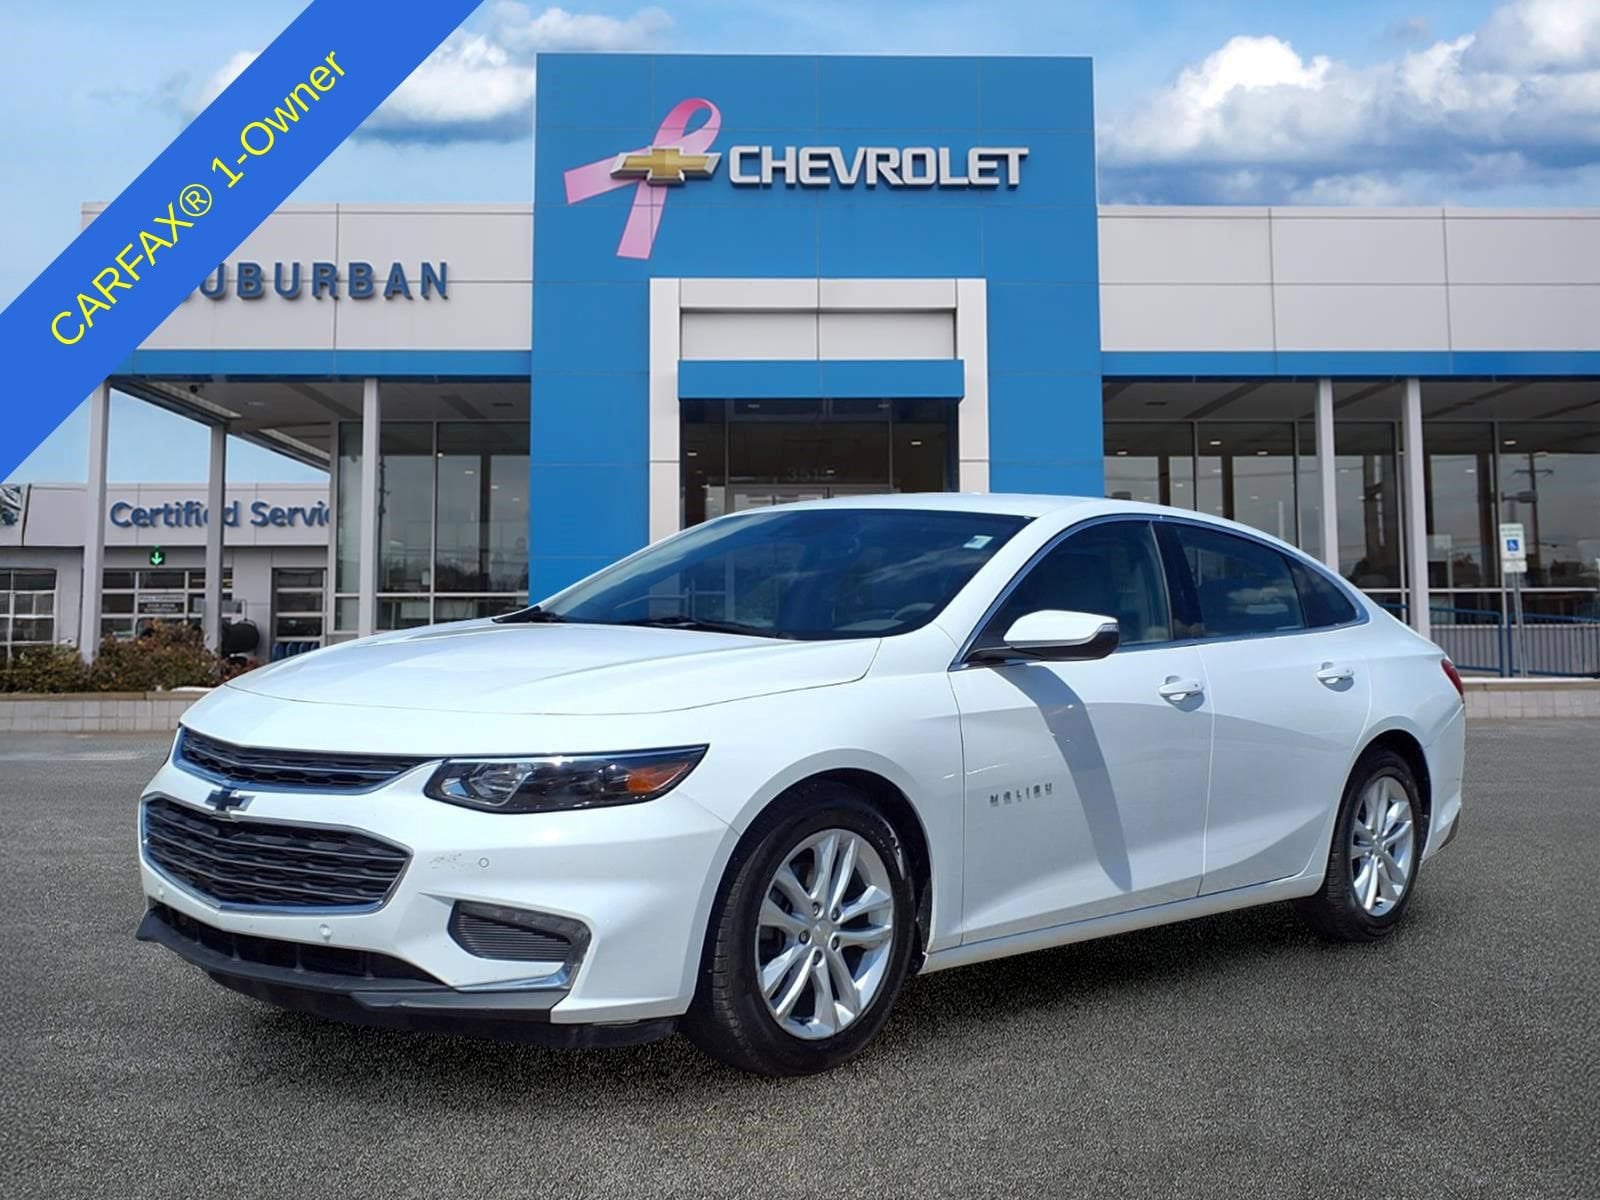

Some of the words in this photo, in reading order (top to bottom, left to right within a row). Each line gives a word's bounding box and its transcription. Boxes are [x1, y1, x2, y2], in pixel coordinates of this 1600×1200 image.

[729, 145, 1029, 187] CHEVROLET
[199, 261, 449, 300] UBURBAN
[989, 782, 1053, 807] MALIBU
